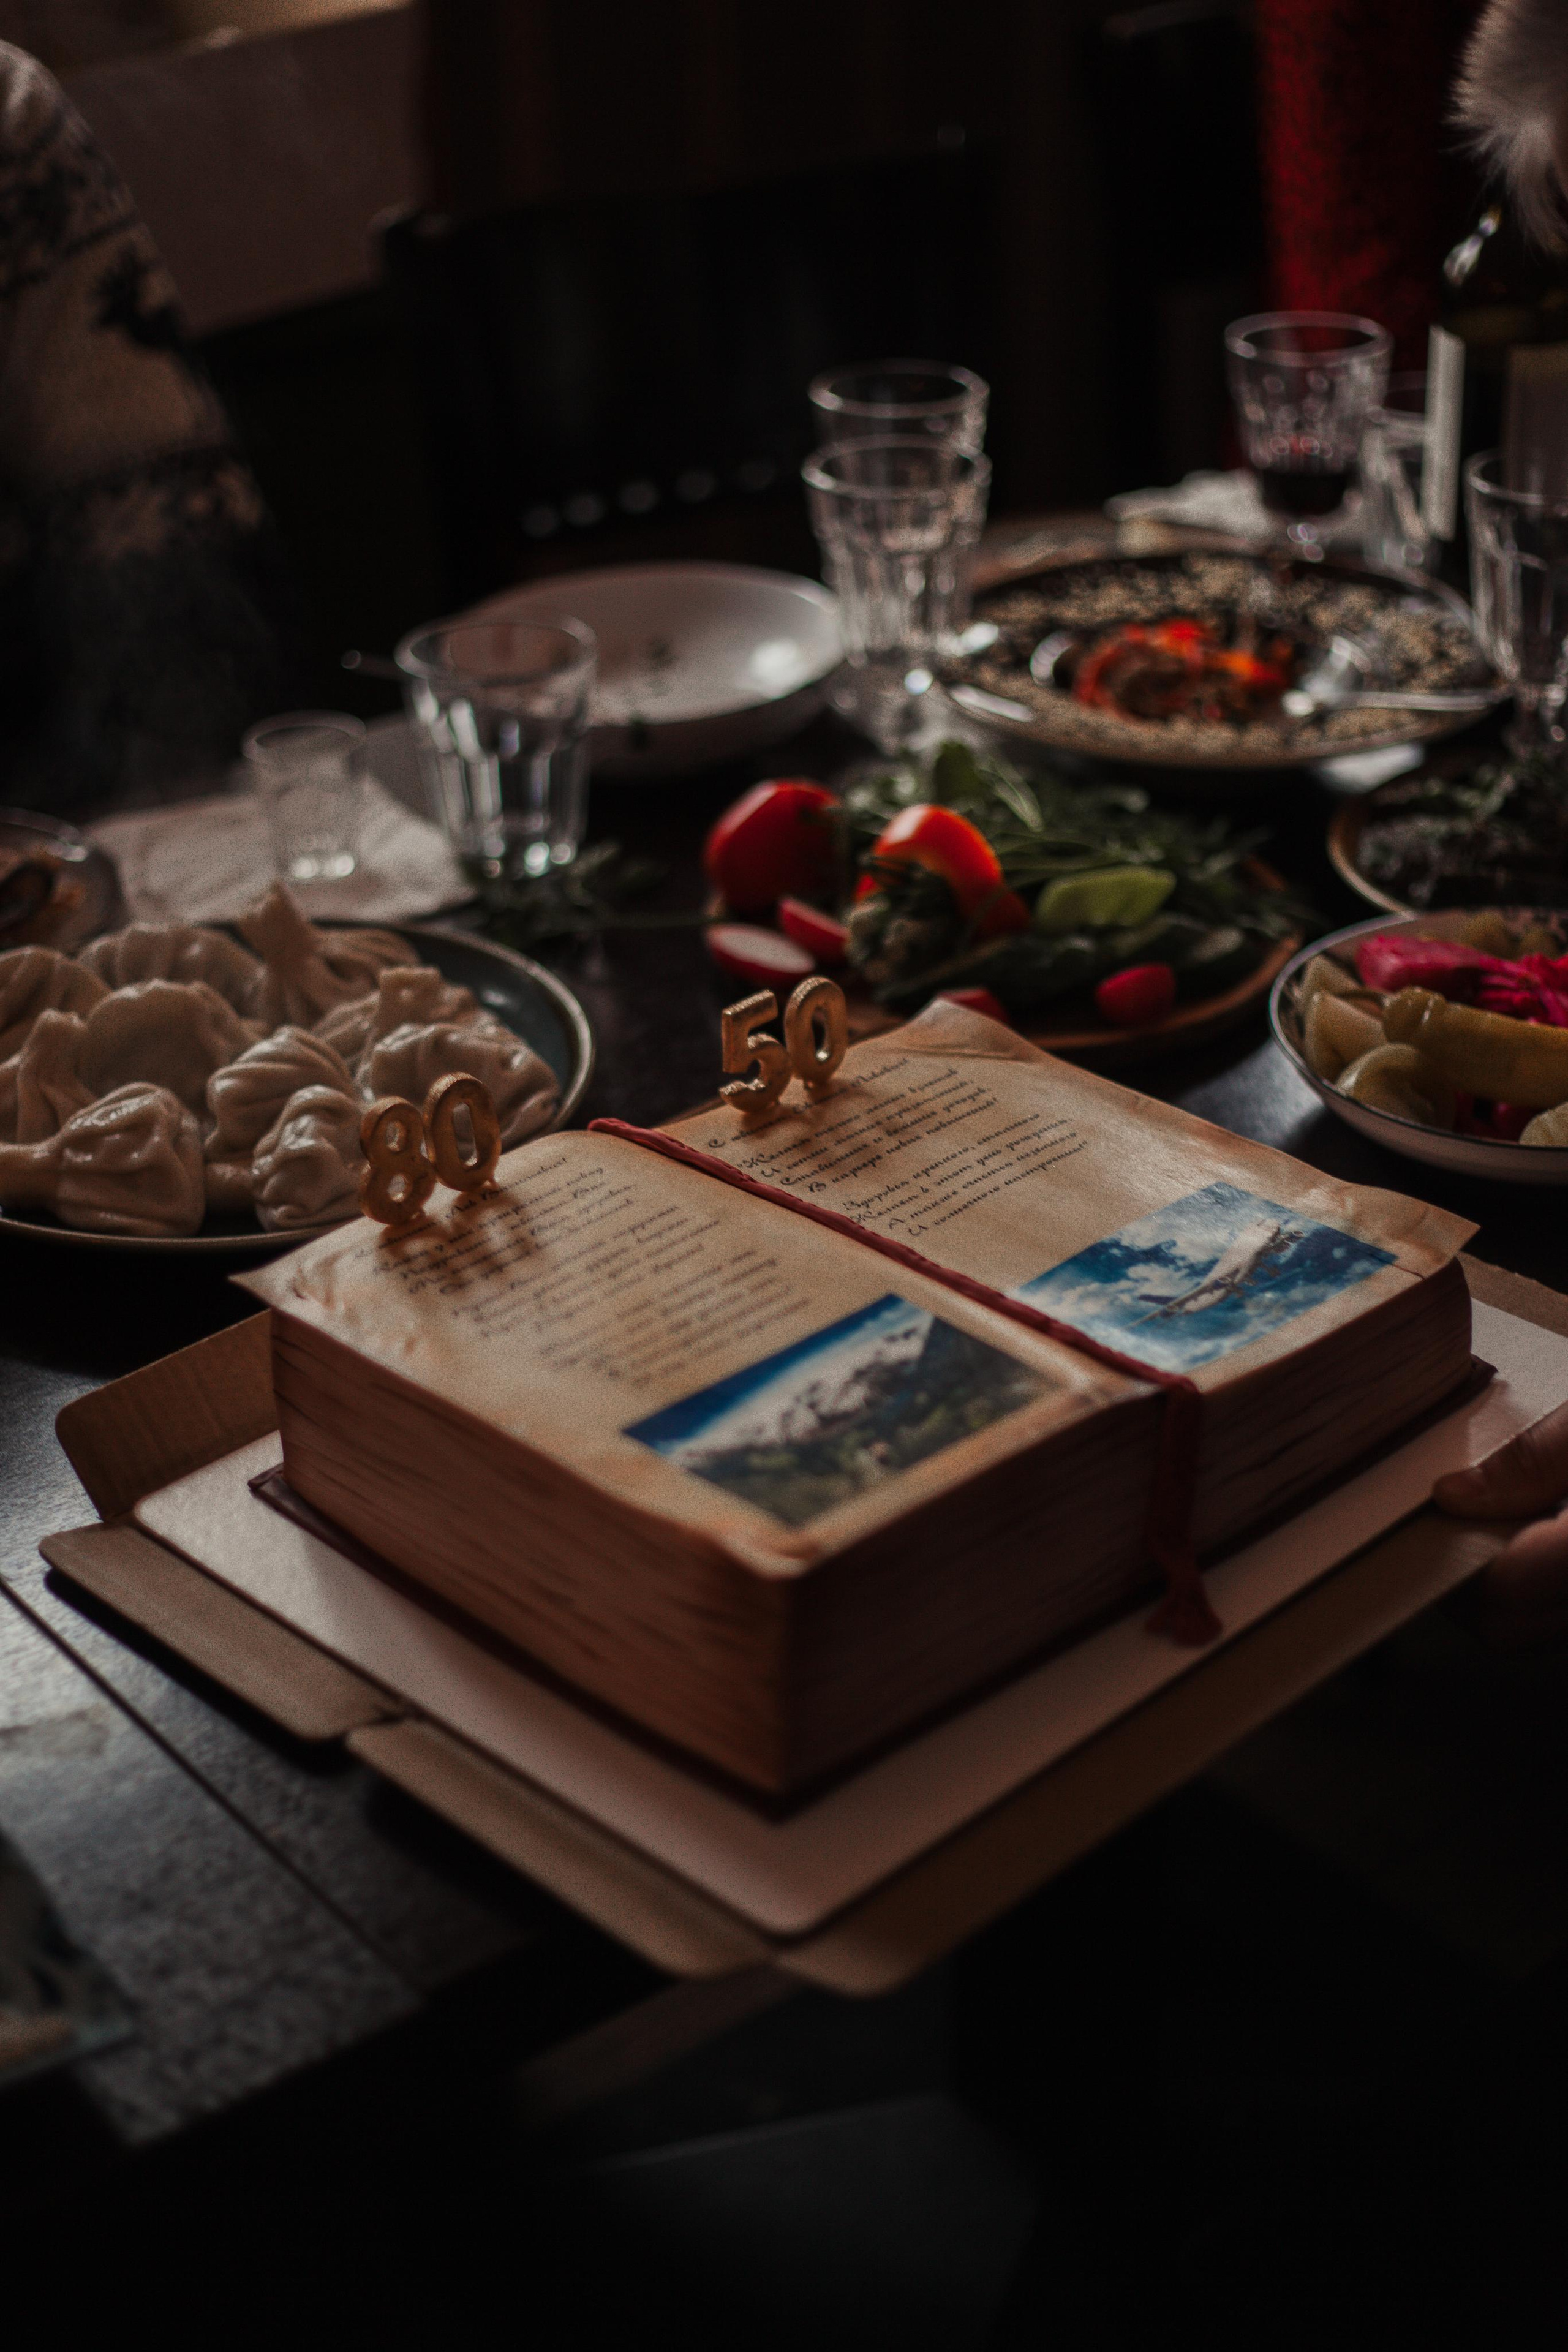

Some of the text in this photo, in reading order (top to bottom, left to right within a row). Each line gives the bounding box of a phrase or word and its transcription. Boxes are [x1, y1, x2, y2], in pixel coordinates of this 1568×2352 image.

[719, 976, 848, 1112] 50
[359, 1072, 502, 1224] 80
[760, 1167, 781, 1177] И
[786, 1147, 827, 1169] сотни
[780, 1144, 869, 1185] Стабильных
[885, 1111, 937, 1136] больших
[809, 1097, 997, 1192] В карьере новых повышений!
[814, 1115, 859, 1137] только
[843, 1114, 1039, 1210] Здоровья крепкого, стального
[850, 1195, 919, 1223] Желаем
[936, 1165, 971, 1185] этот
[976, 1149, 1001, 1166] день
[888, 1132, 1076, 1229] А также счастья неземного
[908, 1224, 928, 1236] И
[934, 1186, 999, 1225] солнечного
